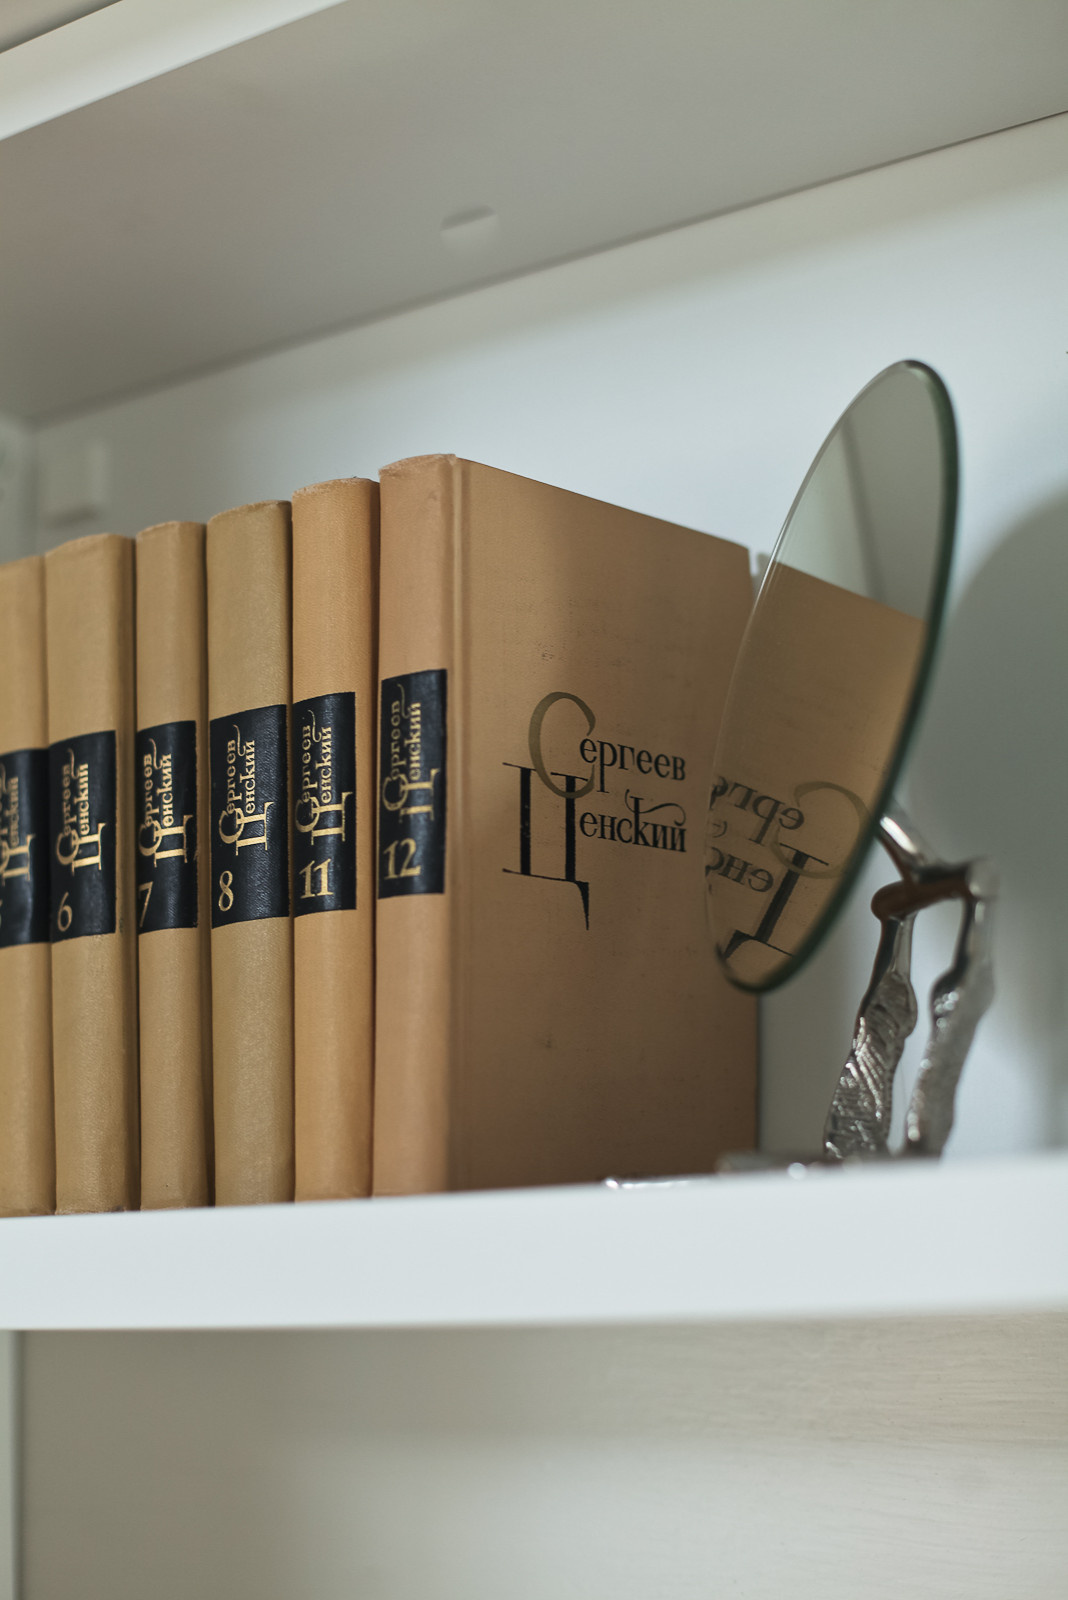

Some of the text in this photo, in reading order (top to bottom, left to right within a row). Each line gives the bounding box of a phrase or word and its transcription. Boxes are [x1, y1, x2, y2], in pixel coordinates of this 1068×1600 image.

[219, 739, 245, 844] Сергеев
[233, 724, 274, 856] Ценский
[295, 725, 320, 833] Сергеев
[308, 710, 353, 845] Ценский
[528, 691, 686, 799] Сергеев
[138, 753, 162, 857] Сергеев
[150, 738, 193, 868] Ценский
[502, 762, 687, 930] Ценский
[57, 892, 72, 931] 6
[139, 881, 153, 928] 7
[218, 870, 233, 911] 8
[299, 858, 334, 899] 11
[384, 838, 421, 880] 12
